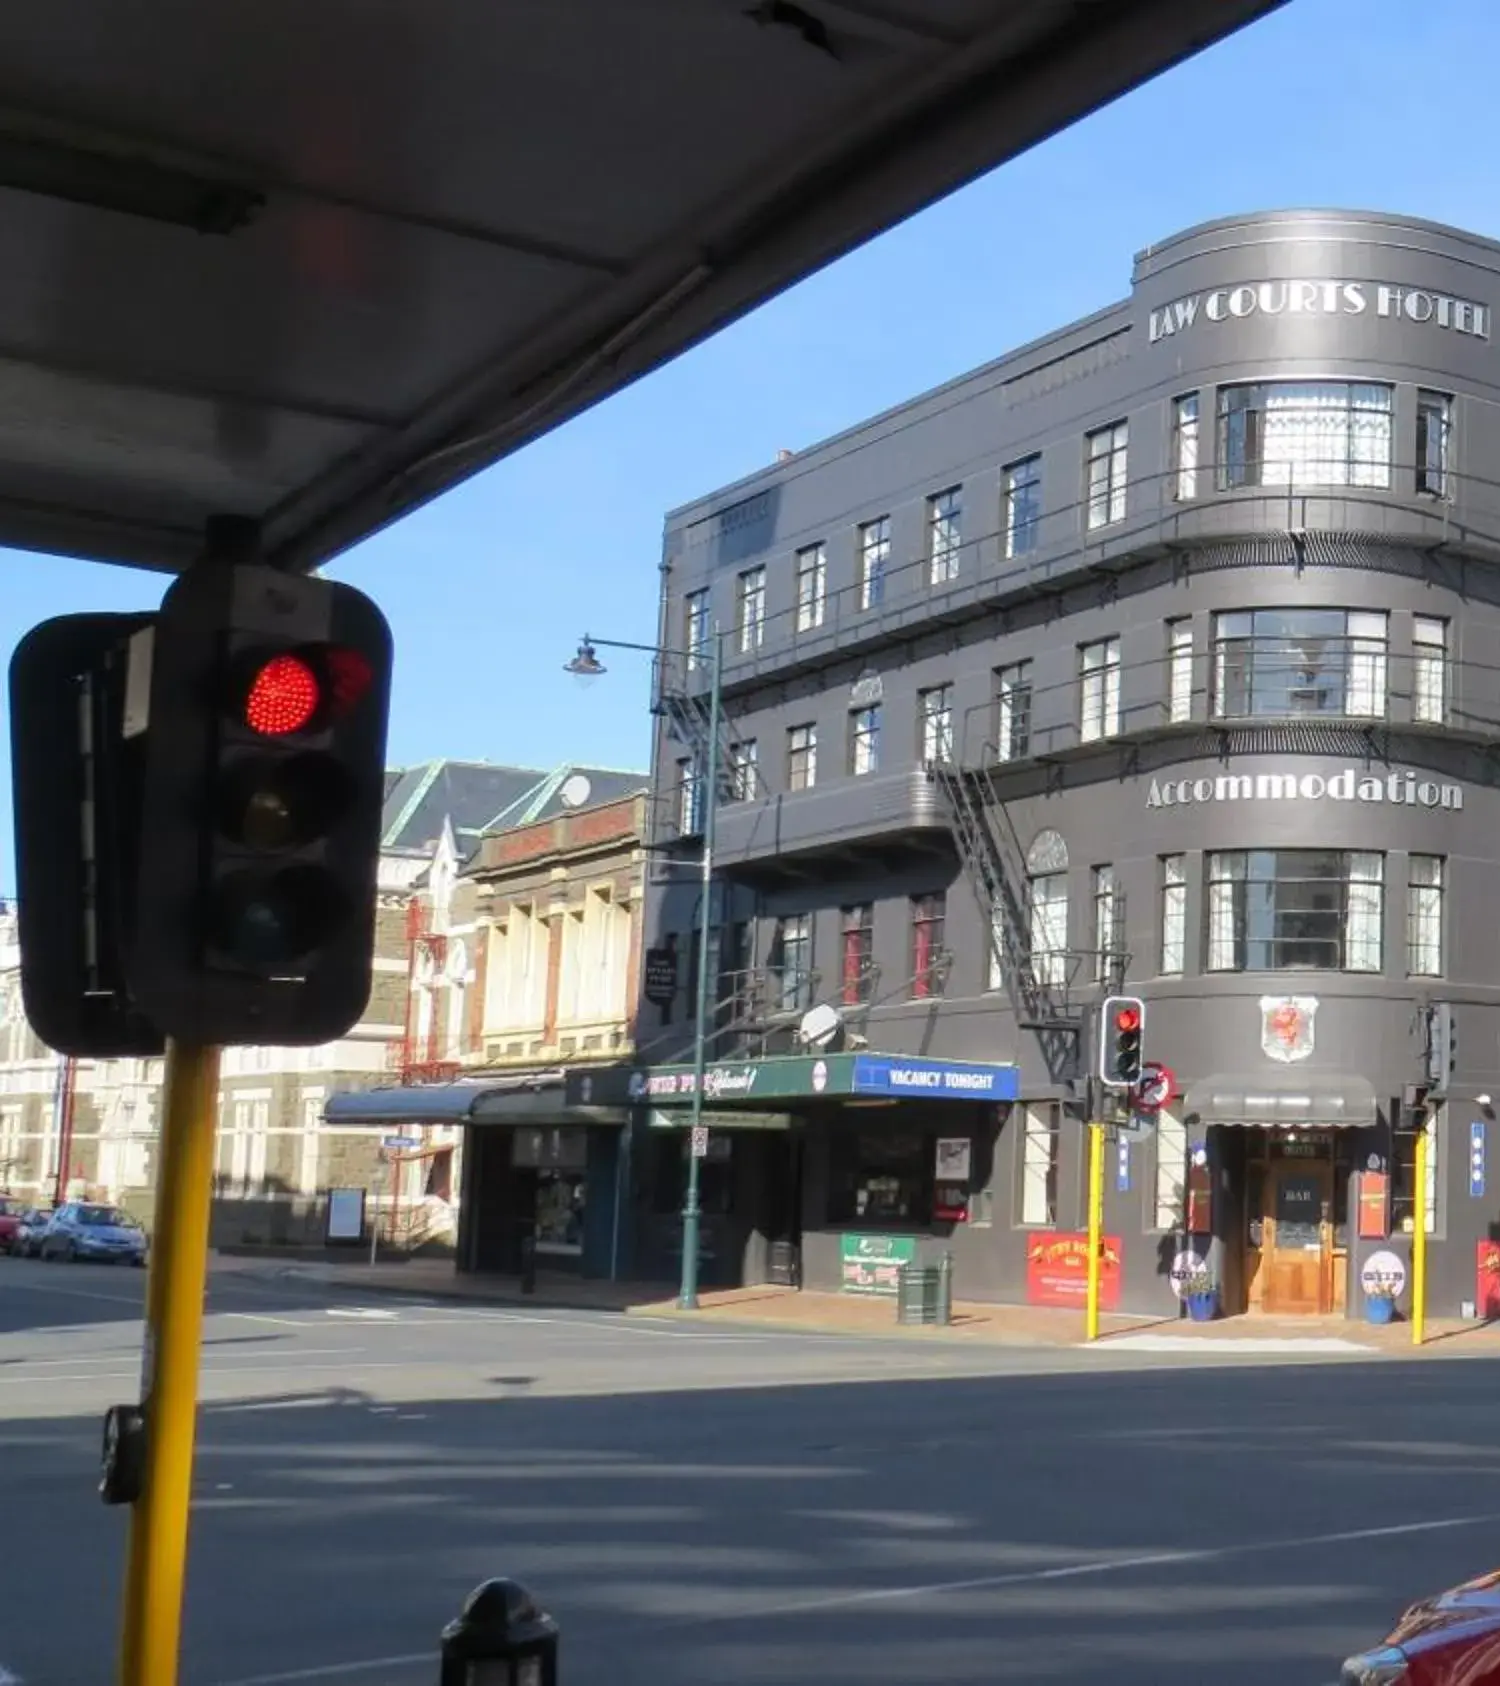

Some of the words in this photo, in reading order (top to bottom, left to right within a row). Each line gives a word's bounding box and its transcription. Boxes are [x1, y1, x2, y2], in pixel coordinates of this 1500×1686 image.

[1149, 295, 1200, 341] LAW
[1206, 282, 1367, 320] COURTS
[1377, 286, 1490, 338] HOTEL
[1146, 769, 1464, 809] Accommodation
[889, 1070, 941, 1088] VACANCY
[944, 1072, 995, 1090] TONIGHT
